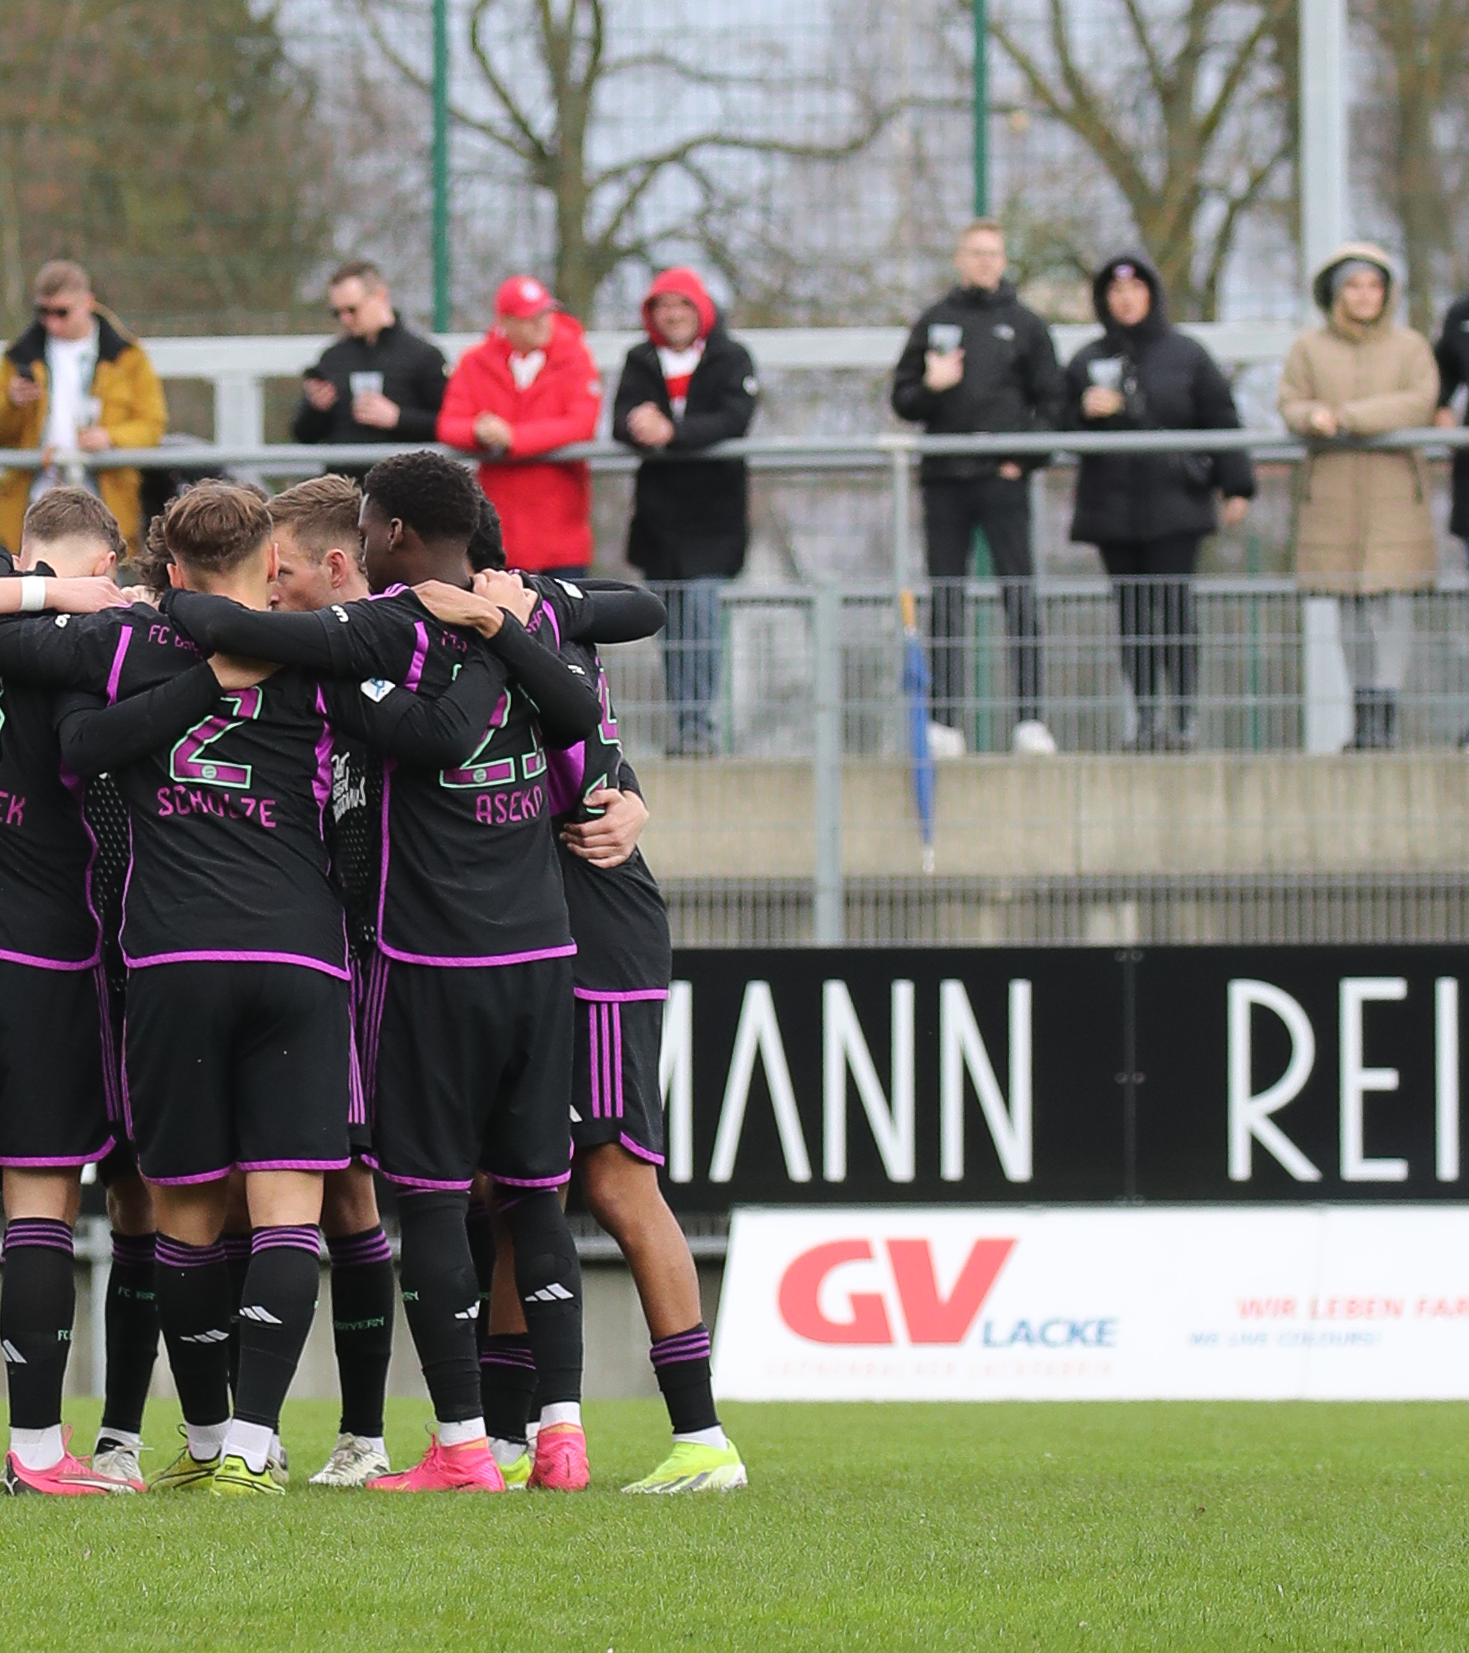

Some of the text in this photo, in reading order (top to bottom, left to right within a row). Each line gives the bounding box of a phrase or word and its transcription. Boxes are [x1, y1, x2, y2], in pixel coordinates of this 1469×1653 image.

[148, 624, 170, 645] FC
[169, 686, 263, 790] 2
[1227, 976, 1461, 1182] REI
[777, 1238, 1018, 1345] GV
[1237, 1297, 1296, 1319] WIR
[1307, 1297, 1404, 1319] LEBEN
[981, 1317, 1119, 1348] LACKE
